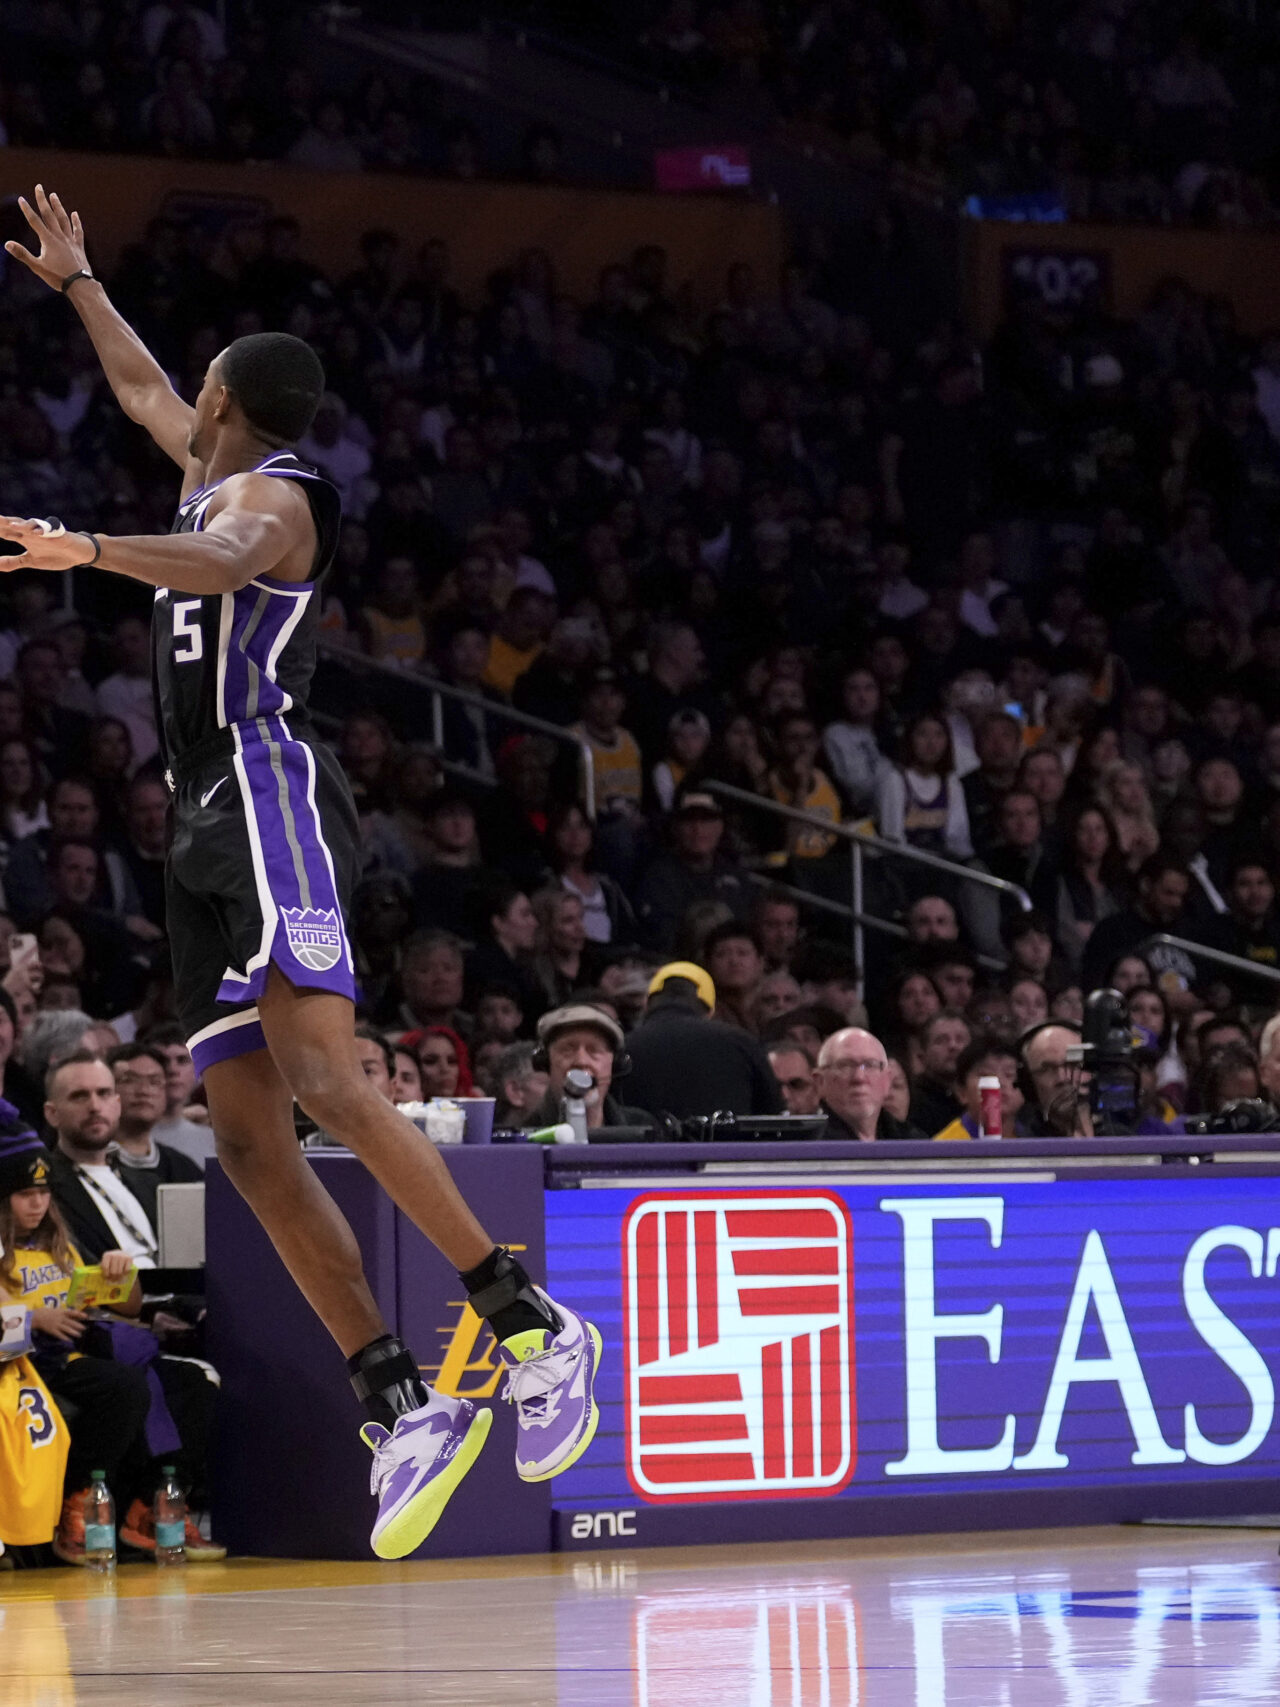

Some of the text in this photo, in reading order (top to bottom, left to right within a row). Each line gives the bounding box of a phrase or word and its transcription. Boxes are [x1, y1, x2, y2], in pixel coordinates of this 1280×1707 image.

[173, 599, 203, 663] 5
[289, 931, 339, 946] KINGS
[880, 1196, 1280, 1476] EAS
[17, 1386, 58, 1450] 3
[570, 1510, 637, 1539] anc
